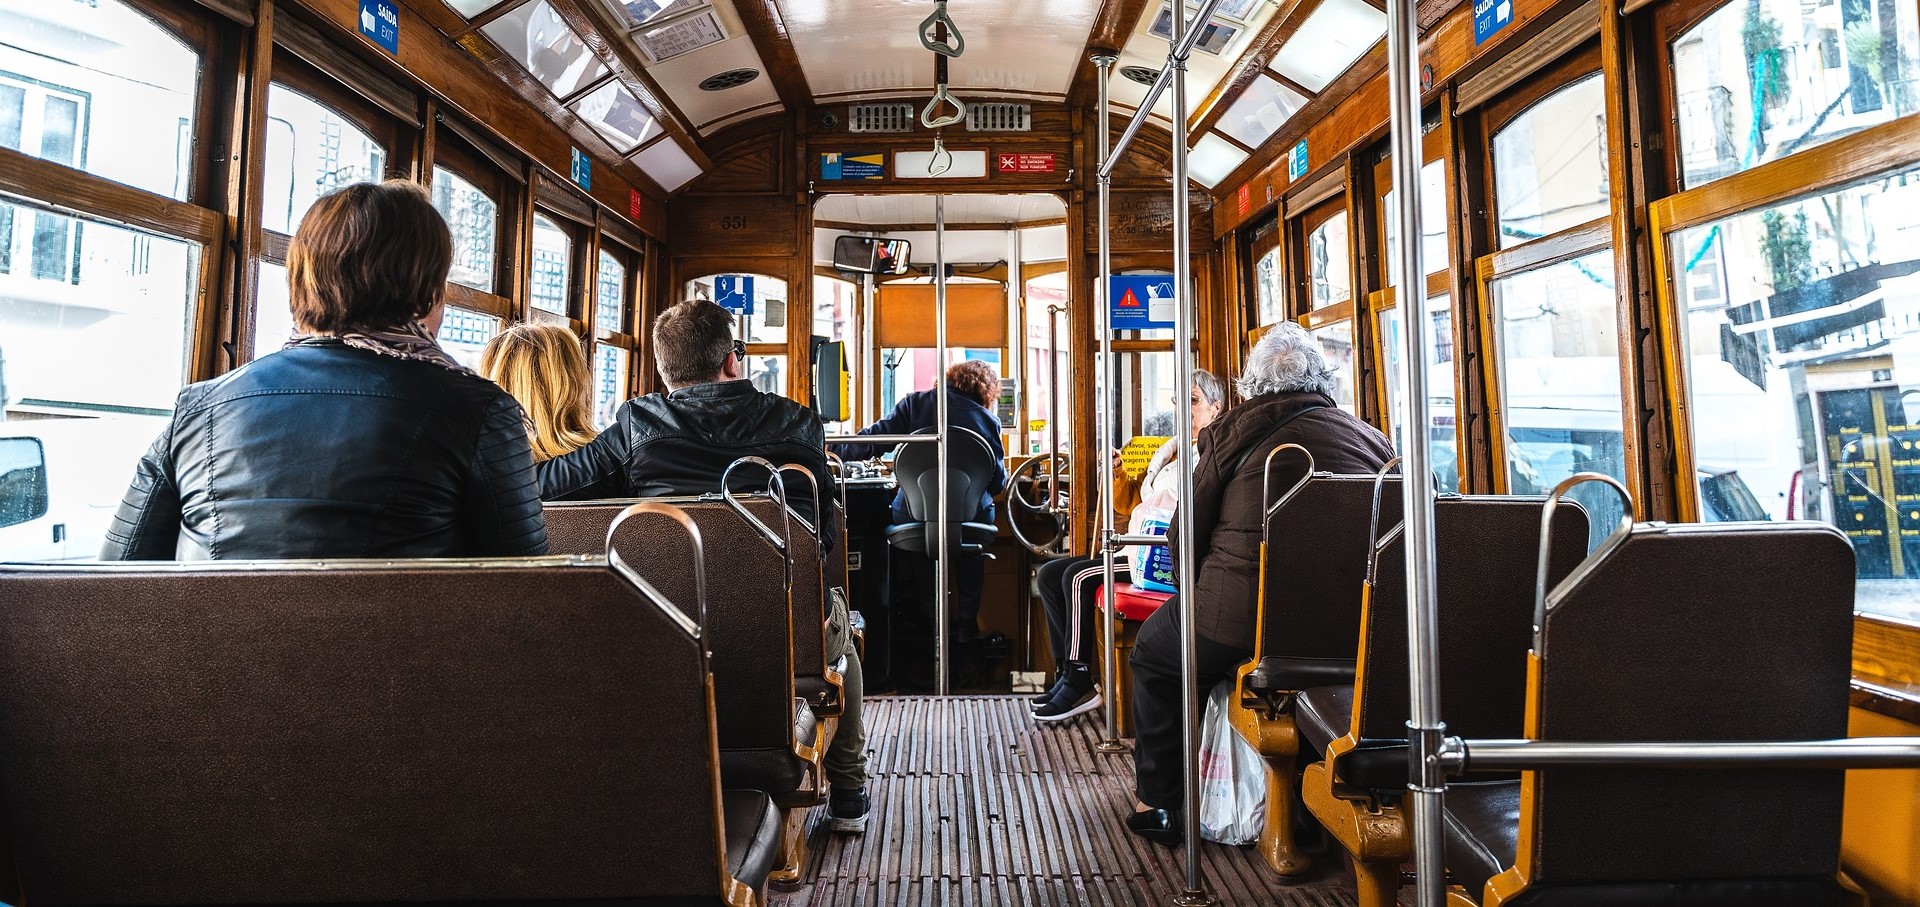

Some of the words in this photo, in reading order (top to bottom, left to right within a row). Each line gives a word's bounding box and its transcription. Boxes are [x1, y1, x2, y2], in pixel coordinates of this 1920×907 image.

[378, 3, 397, 27] SAÍDA
[381, 25, 394, 42] EXIT
[1480, 15, 1491, 34] EXIT
[722, 216, 746, 230] 551
